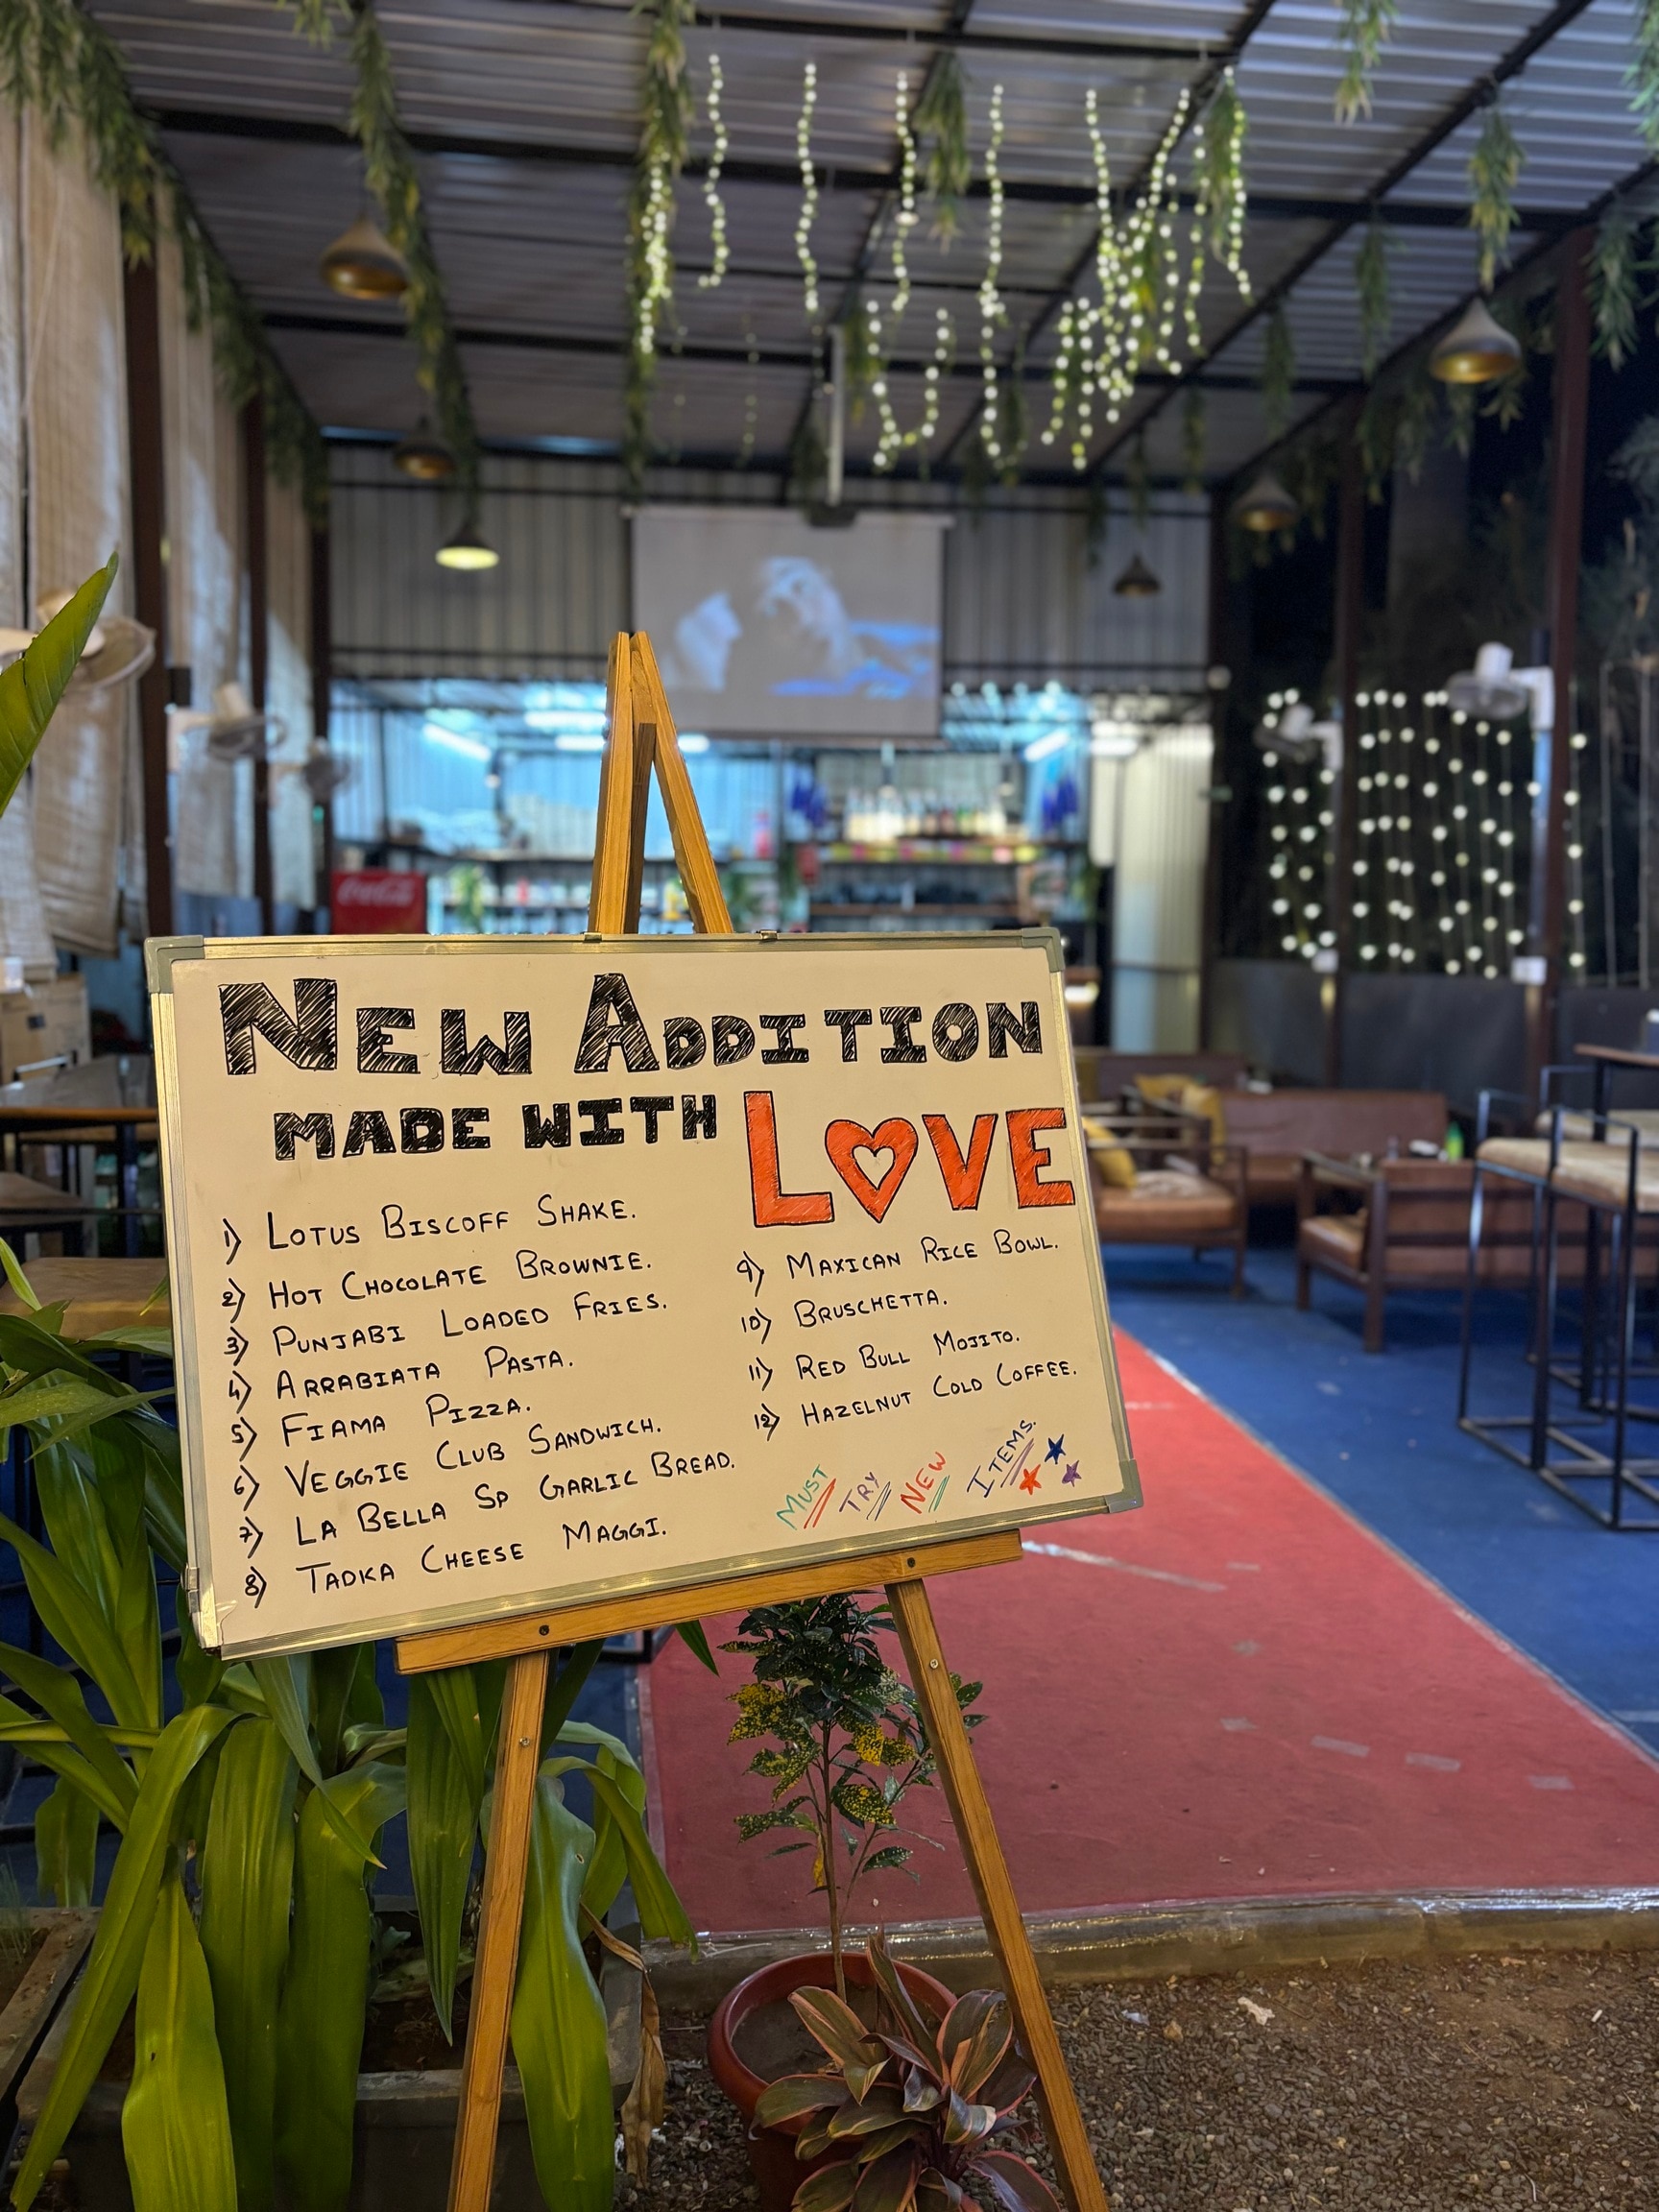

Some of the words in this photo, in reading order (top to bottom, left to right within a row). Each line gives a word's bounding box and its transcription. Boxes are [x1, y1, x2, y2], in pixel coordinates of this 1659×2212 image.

[218, 978, 533, 1078] NEW
[573, 973, 1043, 1074] ADDITION
[274, 1105, 491, 1162] MADE
[522, 1094, 717, 1149] WITH
[223, 1218, 242, 1265] 1)
[268, 1212, 360, 1249] LOTUS
[381, 1204, 509, 1239] BISCOFF
[538, 1194, 636, 1226] SHAKE.
[736, 1251, 764, 1297] 9)
[786, 1252, 901, 1279] MAXICAN
[921, 1237, 977, 1263] RICE
[993, 1228, 1058, 1254] BOWL.
[222, 1278, 246, 1324] 2)
[269, 1281, 322, 1310] HOT
[342, 1264, 487, 1301] CHOCOLATE
[516, 1250, 651, 1279] BROWNIE.
[741, 1308, 772, 1344] 10)
[794, 1289, 949, 1331] BRUSCHETTA.
[224, 1326, 249, 1366] 3)
[273, 1325, 405, 1357] PUNJABI
[441, 1307, 548, 1337] LOADED
[573, 1291, 666, 1320] FRIES.
[749, 1357, 773, 1391] 11)
[796, 1355, 846, 1380] RED
[858, 1344, 910, 1368] BULL
[933, 1330, 1020, 1356] MOJITO.
[228, 1370, 252, 1414] 4)
[277, 1362, 442, 1400] ARRABIATA
[484, 1346, 573, 1378] PASTA.
[755, 1403, 781, 1441] 12)
[802, 1392, 911, 1427] HAZELNUT
[933, 1375, 982, 1397] COLD
[997, 1360, 1076, 1387] COFFEE.
[231, 1416, 257, 1462] 5)
[281, 1412, 385, 1447] FIAMA
[426, 1394, 532, 1428] PIZZA.
[234, 1465, 260, 1511] 6)
[284, 1460, 408, 1497] VEGGIE
[437, 1440, 506, 1469] CLUB
[529, 1418, 661, 1455] SANDWICH.
[239, 1516, 263, 1559] 7)
[296, 1516, 337, 1546] LA
[357, 1503, 445, 1532] BELLA
[539, 1470, 637, 1501] GARLIC
[651, 1452, 734, 1478] BREAD.
[777, 1465, 827, 1530] MUST
[839, 1472, 879, 1514] TRY
[901, 1452, 947, 1514] NEW
[967, 1420, 1037, 1498] ITEMS.
[245, 1566, 267, 1608] 8)
[296, 1562, 395, 1594] TADKA
[421, 1544, 523, 1573] CHEESE
[563, 1518, 666, 1550] MAGGI.
